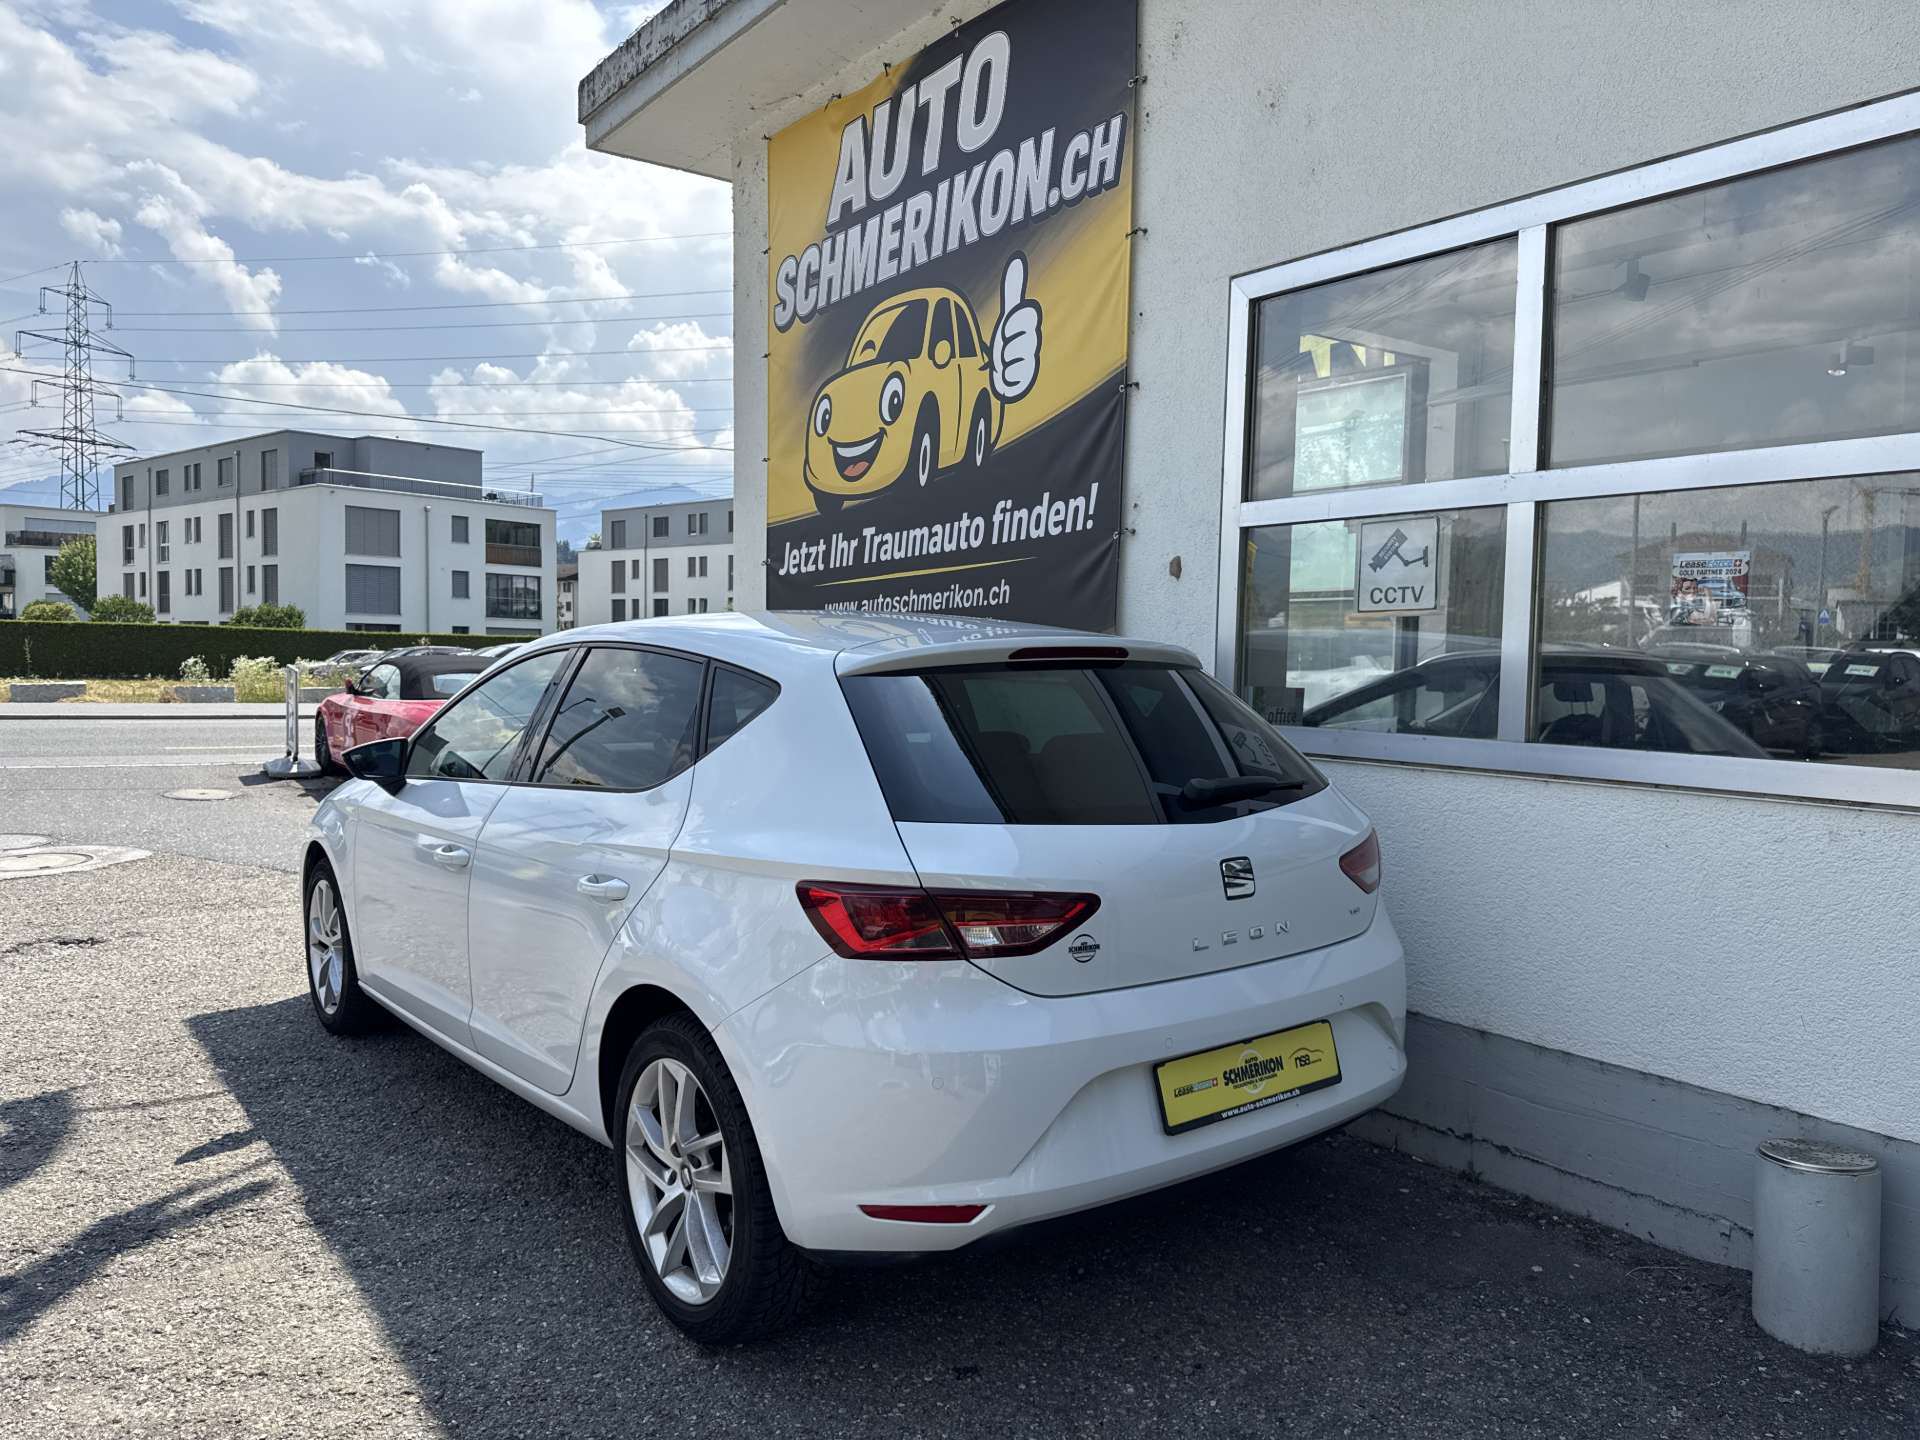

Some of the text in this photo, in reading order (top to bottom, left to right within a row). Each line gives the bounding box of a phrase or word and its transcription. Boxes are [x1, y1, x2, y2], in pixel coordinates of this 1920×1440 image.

[826, 30, 1011, 228] AUTO
[774, 112, 1125, 329] SCHMERIKON.CH
[778, 482, 1099, 576] Jetzt Ihr Traumauto finden!
[824, 579, 1010, 613] wwwautoschmerikon.ch
[1370, 585, 1424, 604] CCTV
[1192, 920, 1290, 952] LEON
[1222, 1056, 1284, 1087] SCHMERIKON
[1244, 1056, 1258, 1067] AUTO
